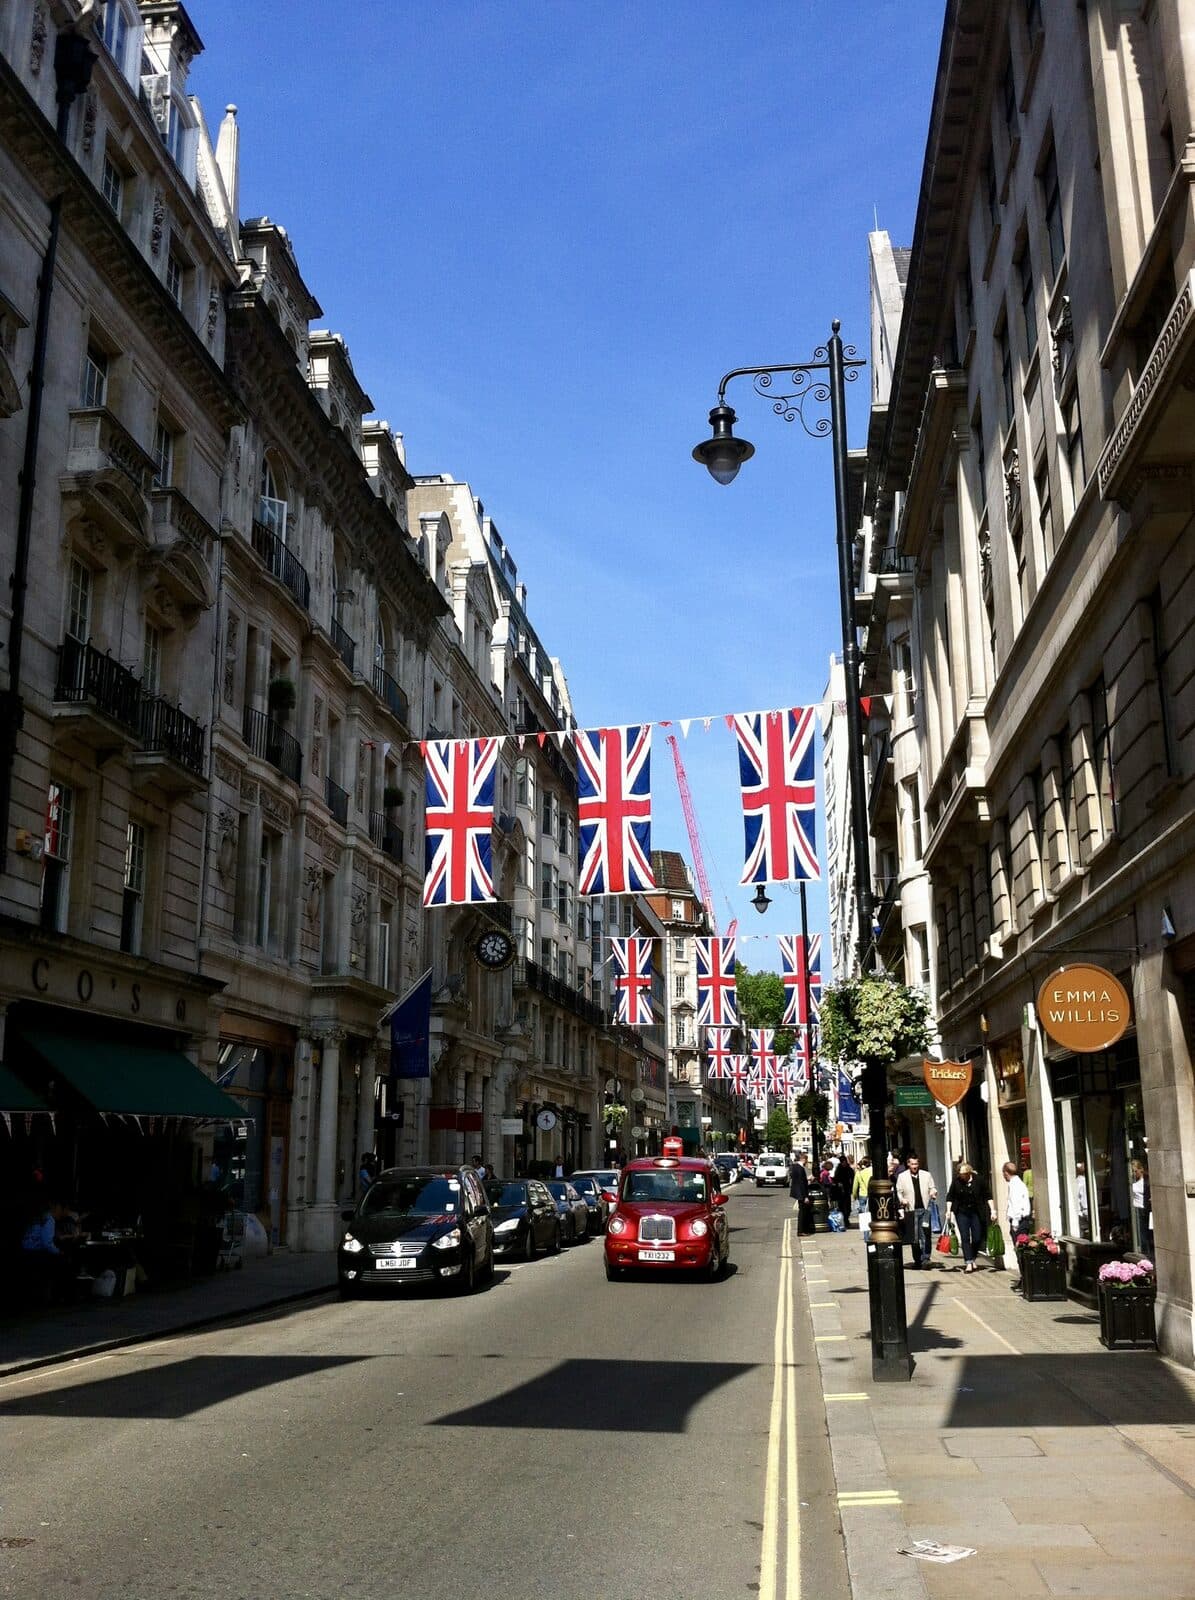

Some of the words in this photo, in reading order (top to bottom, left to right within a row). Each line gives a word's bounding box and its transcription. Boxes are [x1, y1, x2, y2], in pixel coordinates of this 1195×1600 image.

[32, 957, 141, 1014] CO'S
[1054, 990, 1111, 1003] EMMA
[1049, 1009, 1120, 1022] WILLIS
[929, 1067, 967, 1079] Tricker's
